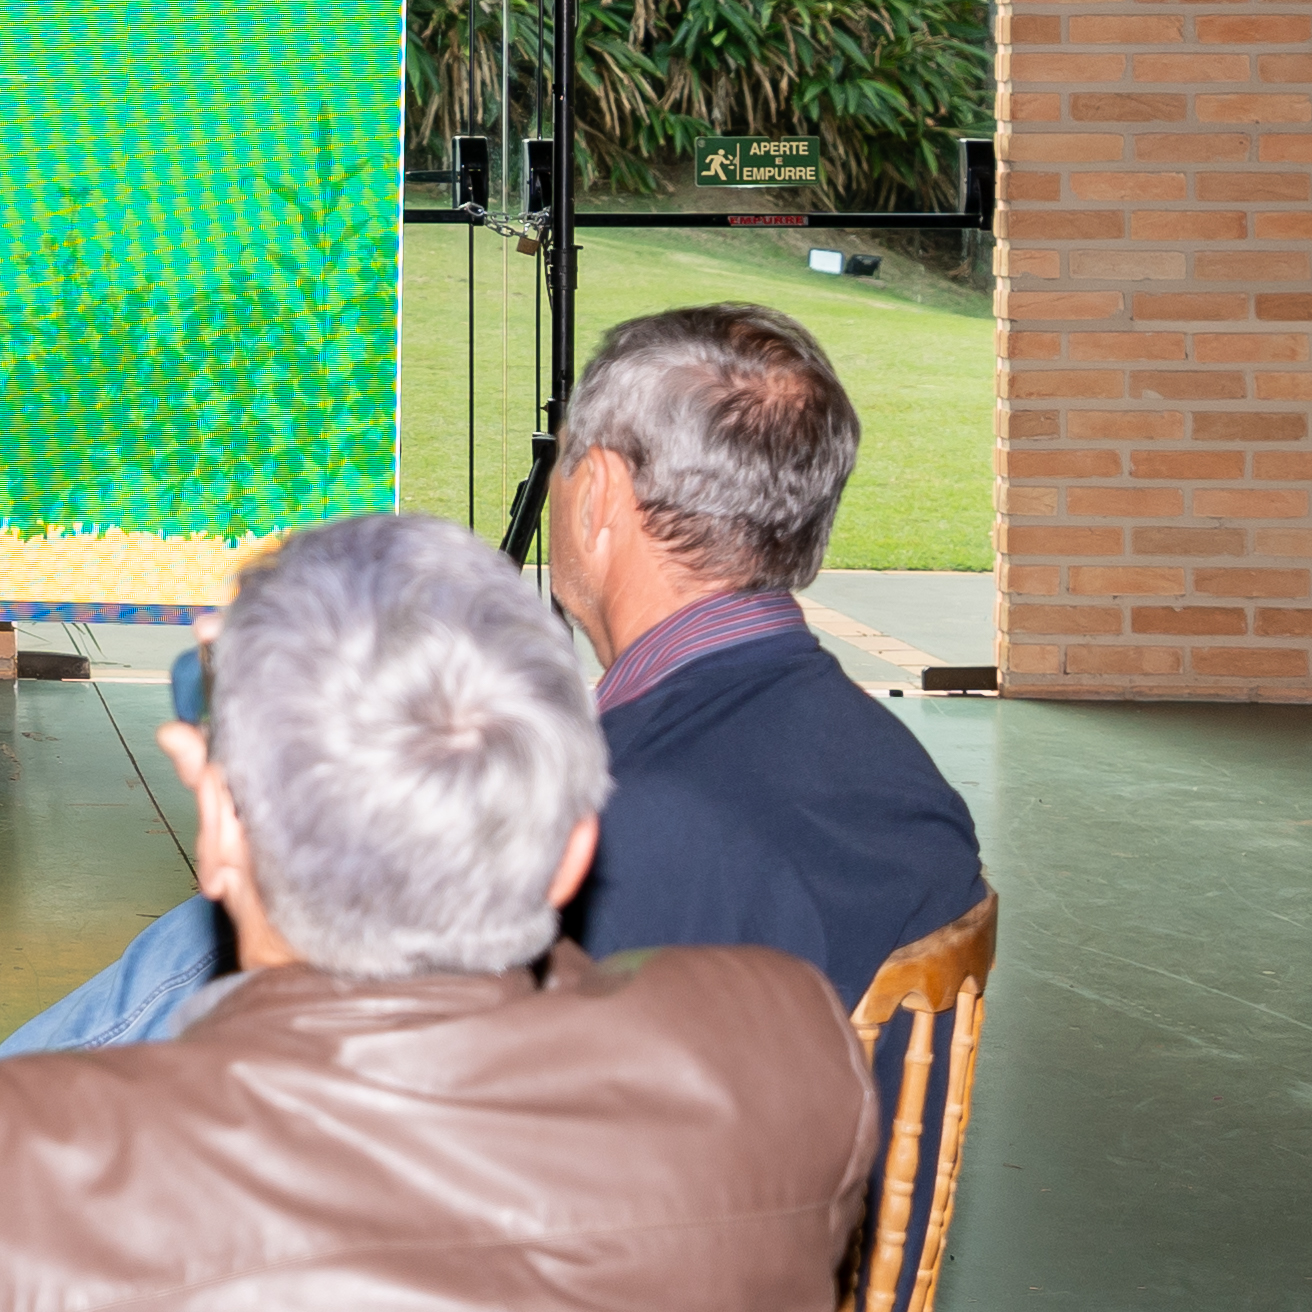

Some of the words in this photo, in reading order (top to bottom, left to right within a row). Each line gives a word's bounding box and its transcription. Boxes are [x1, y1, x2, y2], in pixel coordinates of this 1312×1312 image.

[749, 141, 809, 156] APERTE
[775, 157, 783, 165] E
[742, 166, 816, 181] EMPURRE
[729, 216, 805, 226] EMPURRE
